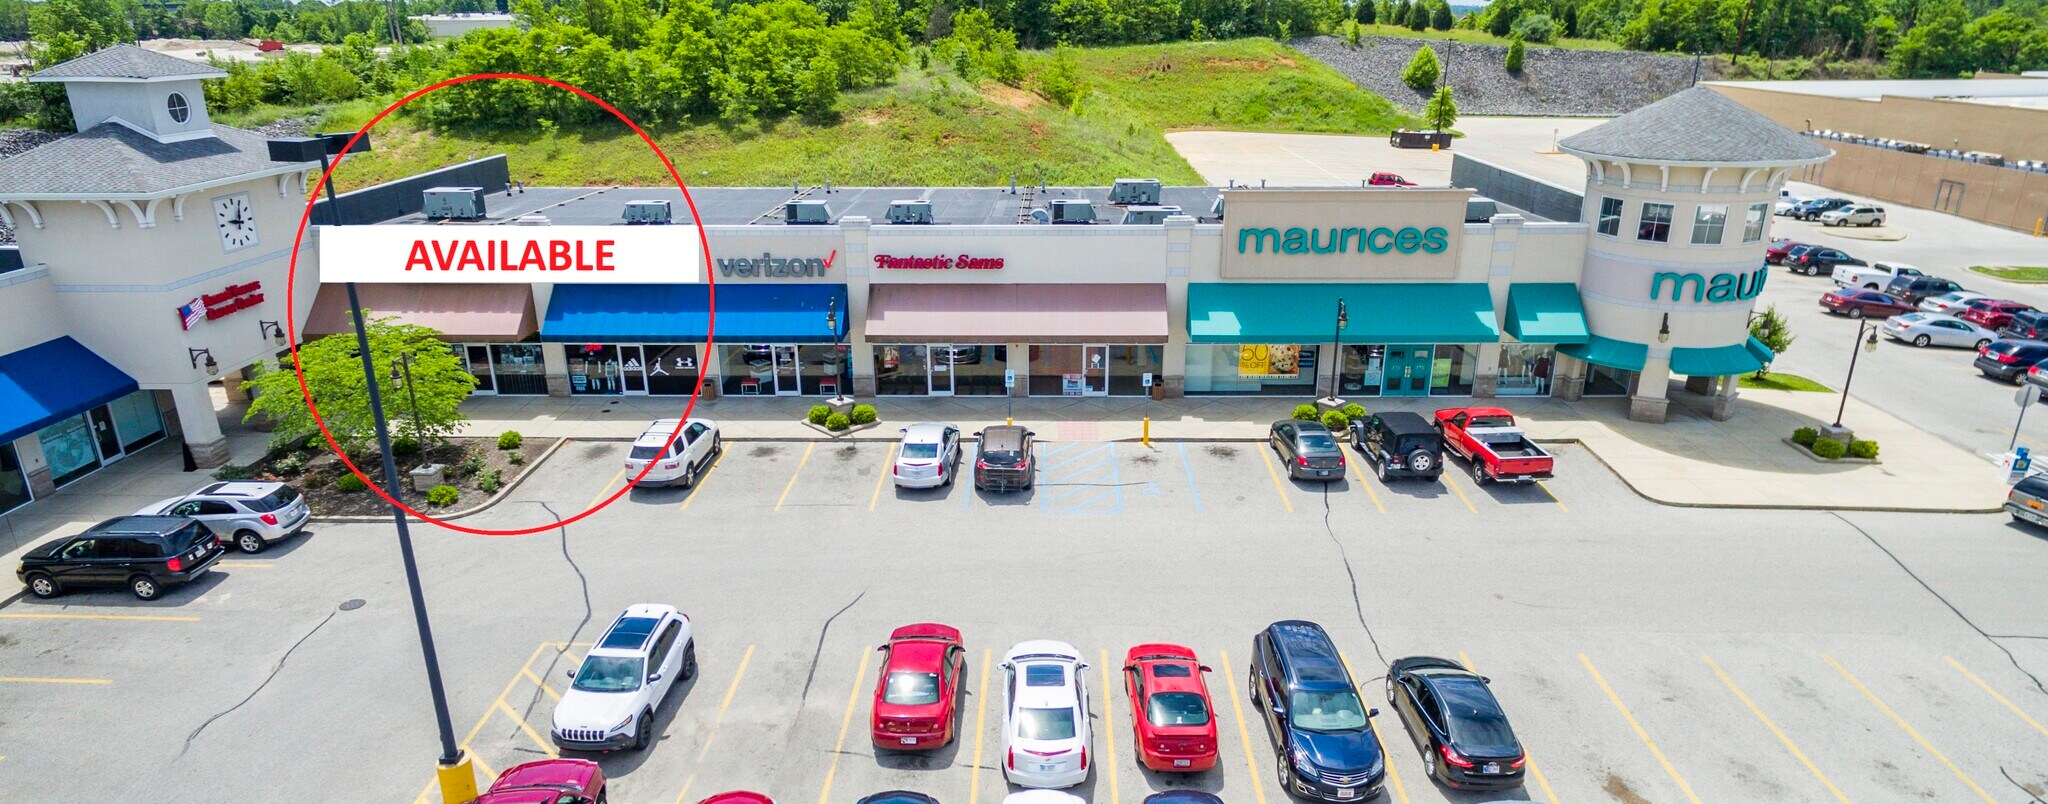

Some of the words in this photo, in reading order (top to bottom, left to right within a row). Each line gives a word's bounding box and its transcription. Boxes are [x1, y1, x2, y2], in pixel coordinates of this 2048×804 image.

[1238, 226, 1449, 254] maurices
[717, 252, 825, 277] verizon
[873, 254, 953, 269] Fantastic
[954, 254, 1004, 269] Sams
[1242, 344, 1268, 361] 50
